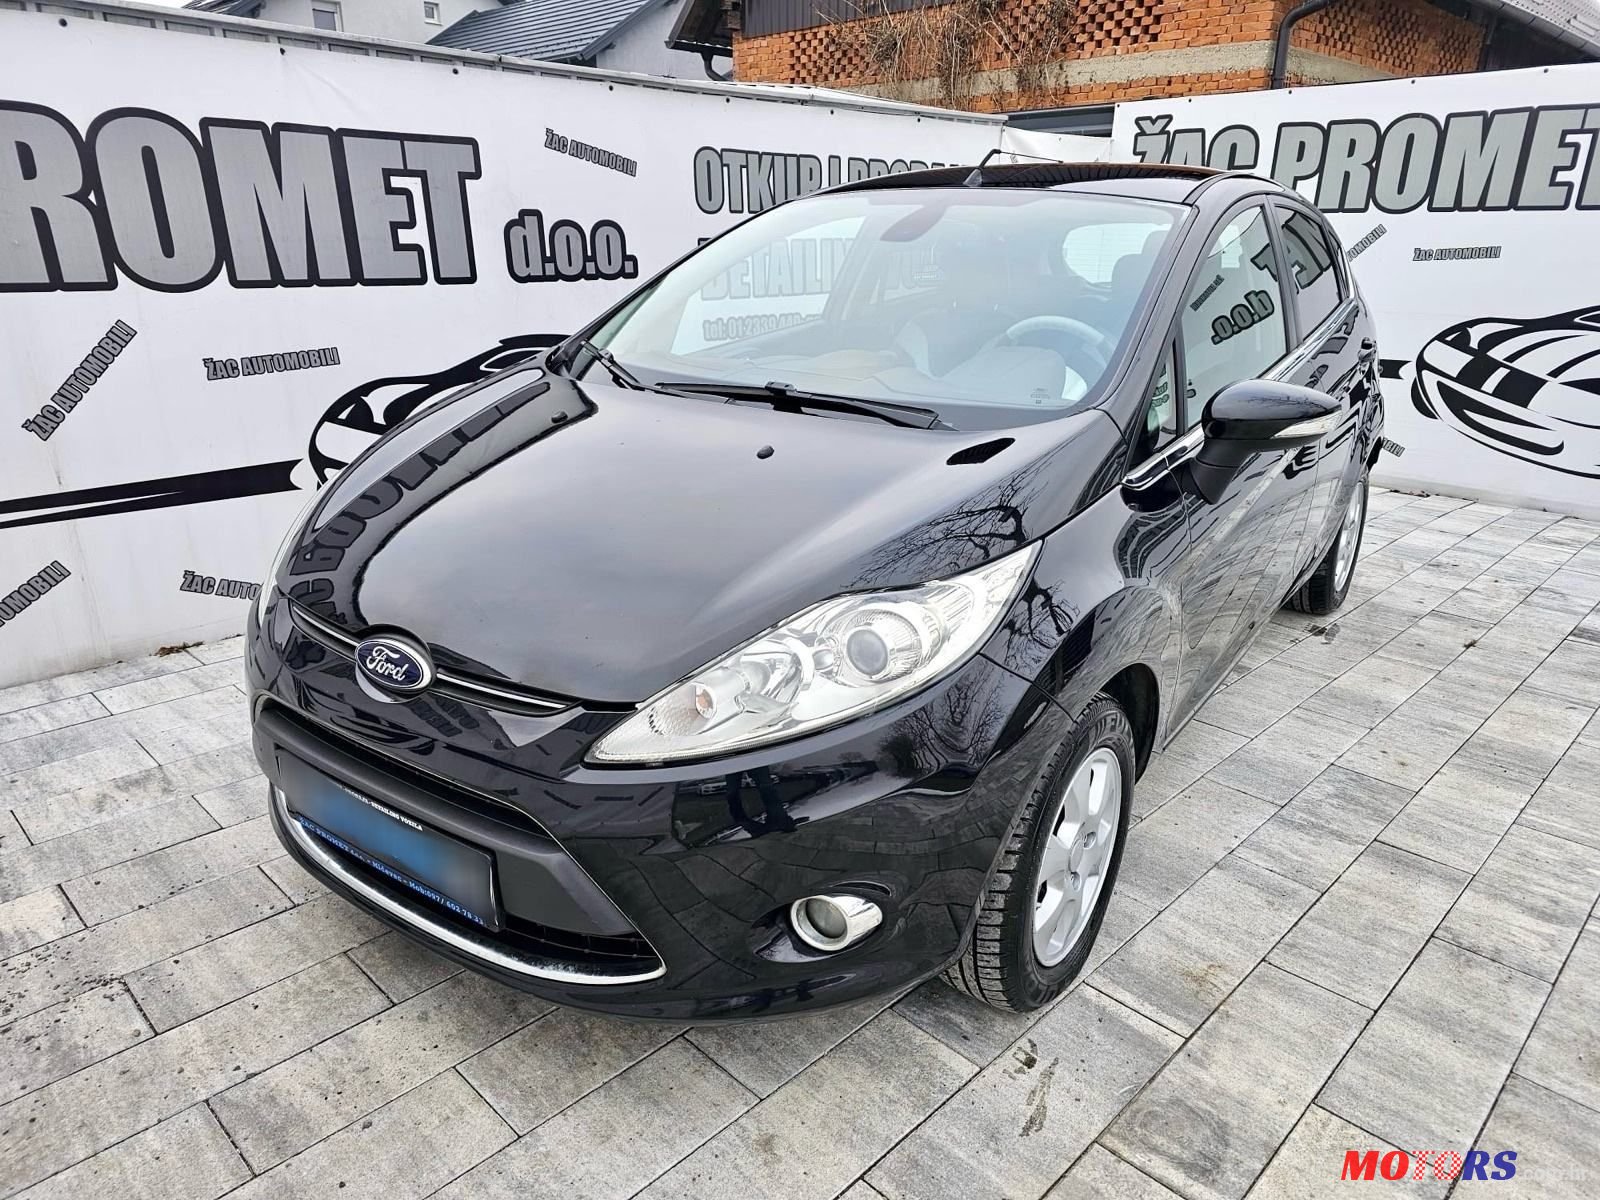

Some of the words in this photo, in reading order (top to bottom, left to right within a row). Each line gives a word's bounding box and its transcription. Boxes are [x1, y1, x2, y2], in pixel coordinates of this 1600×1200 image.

[544, 127, 569, 154] ŽAC
[568, 139, 637, 177] AUTOMOBILI
[0, 100, 482, 293] ROMET
[503, 209, 639, 283] d.o.o.
[693, 146, 822, 214] OTKUP
[1412, 247, 1434, 261] ŽAC
[1433, 245, 1501, 260] AUTOMOBILI
[21, 404, 66, 441] ŽAC
[51, 319, 137, 413] AUTOMOBILI
[202, 357, 240, 380] ŽAC
[240, 347, 340, 376] AUTOMOBILI
[0, 560, 71, 628] OMOBILI
[180, 570, 216, 595] ŽAC
[215, 579, 262, 600] AUTO
[366, 646, 409, 681] Ford
